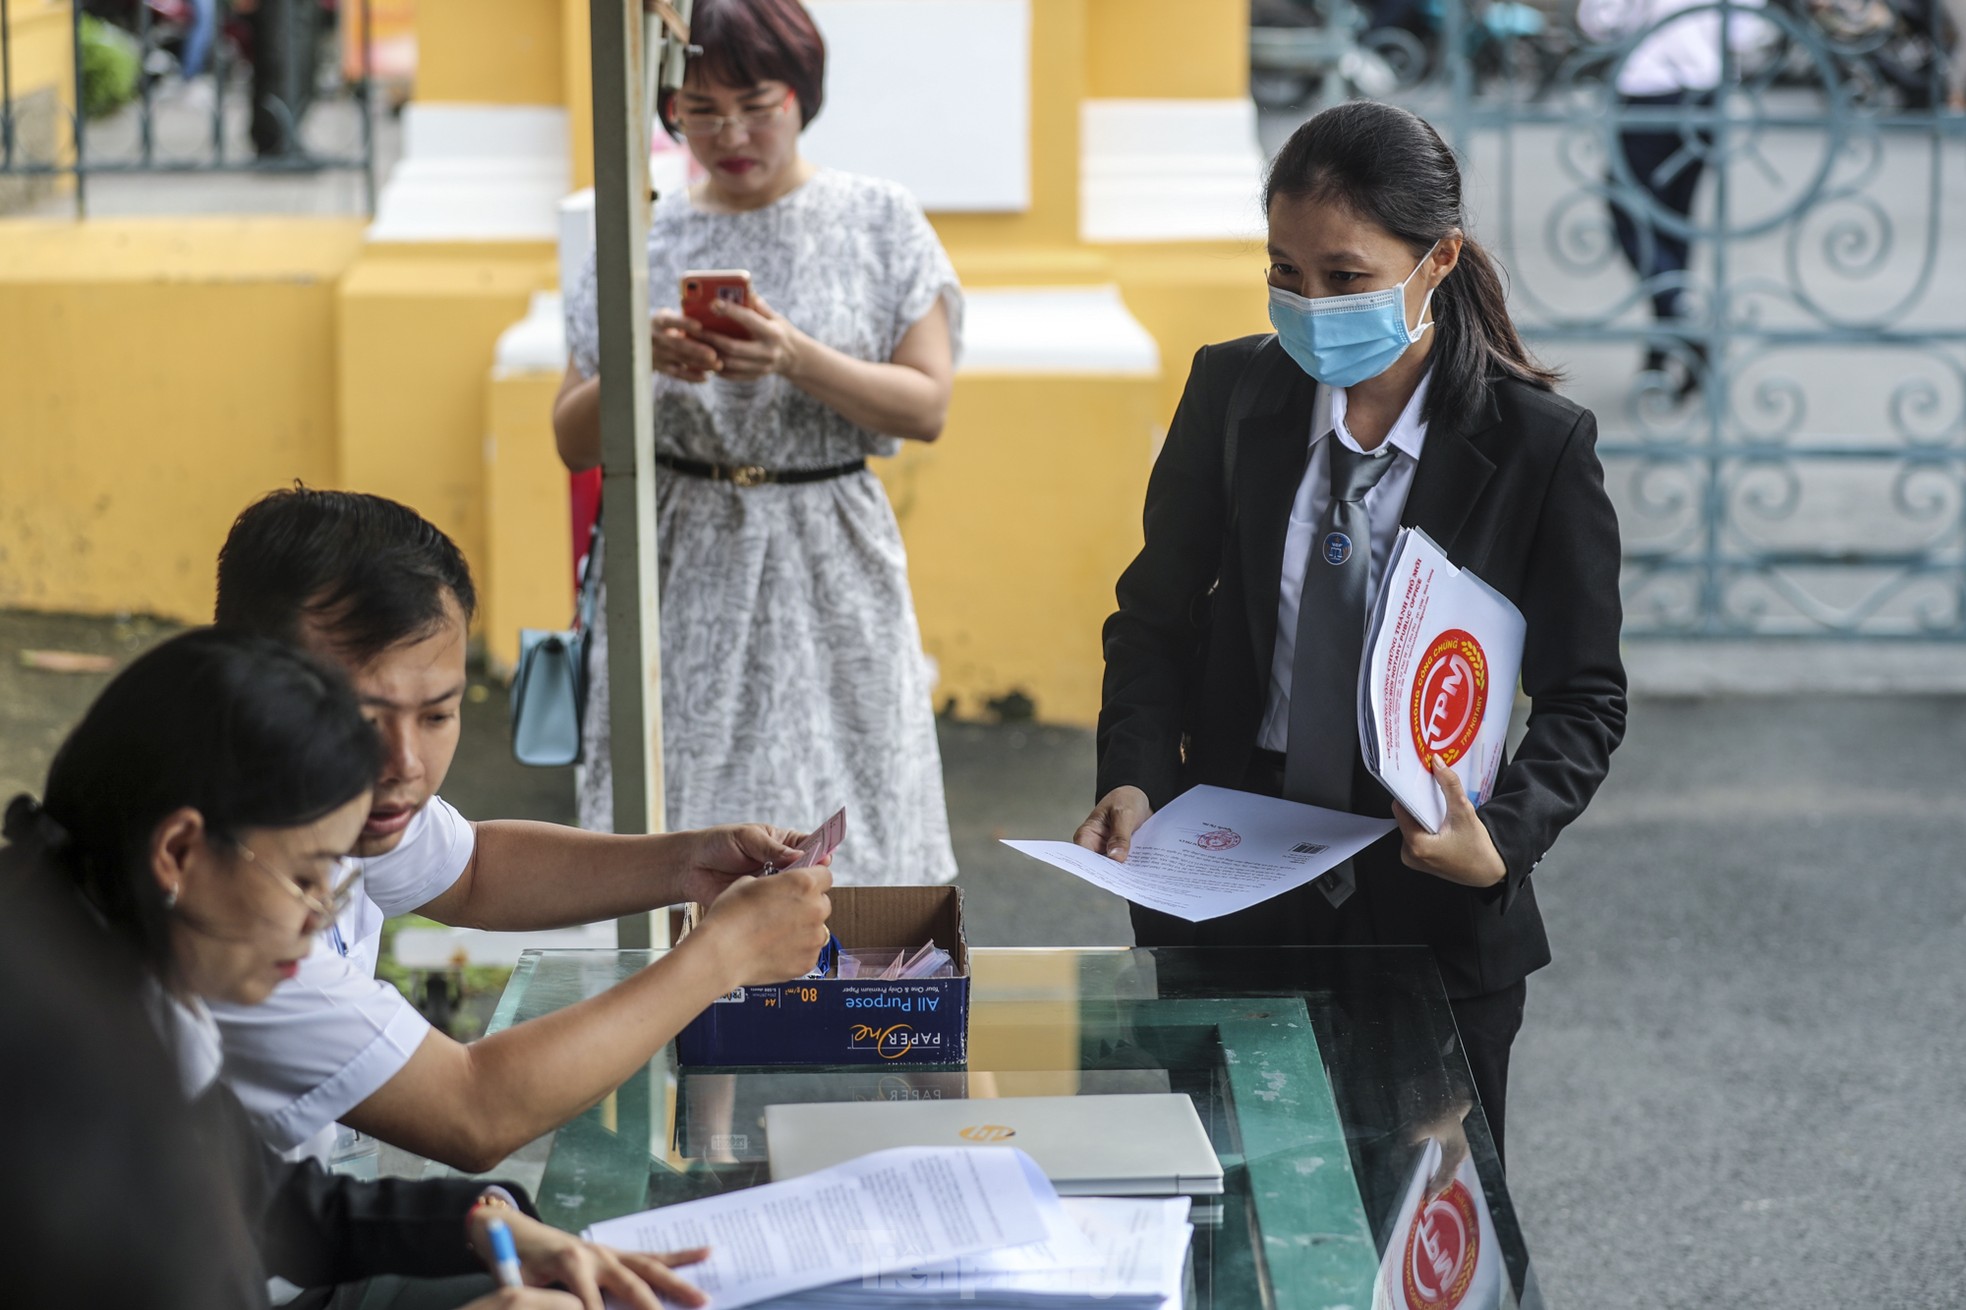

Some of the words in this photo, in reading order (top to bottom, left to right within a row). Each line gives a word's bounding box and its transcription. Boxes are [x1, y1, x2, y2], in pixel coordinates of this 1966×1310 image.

[1395, 601, 1408, 635] THÀNH
[1405, 577, 1415, 599] PHỐ
[1412, 558, 1423, 578] MỚI
[1392, 642, 1402, 678] NOTARY
[1400, 611, 1412, 642] PUBLIC
[1410, 578, 1423, 608] OFFICE
[1427, 654, 1464, 738] TPM
[1460, 728, 1473, 746] TPM
[1470, 696, 1483, 731] NOTARY
[801, 987, 818, 1003] 80
[843, 986, 859, 994] Paper
[888, 985, 903, 993] Only
[764, 998, 777, 1007] A4
[845, 993, 911, 1012] Purpose
[917, 997, 940, 1012] All
[849, 1024, 913, 1060] One
[887, 1033, 941, 1046] PAPER
